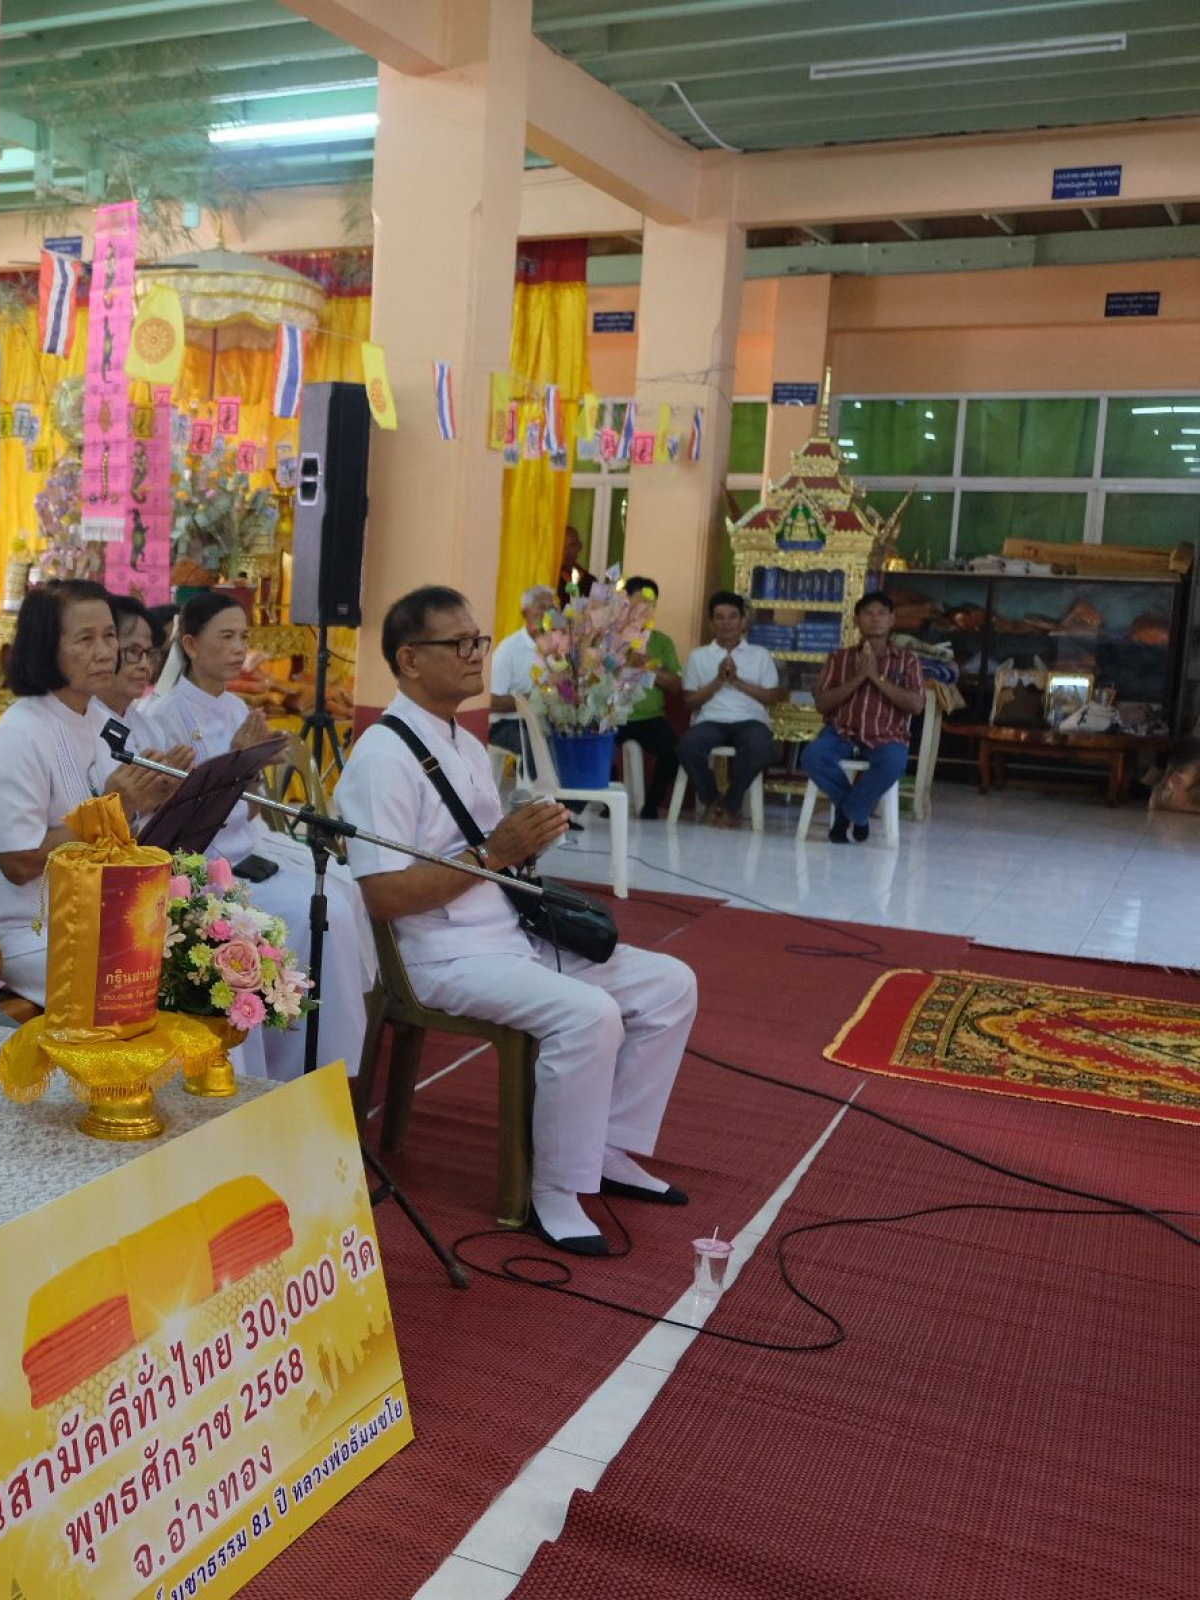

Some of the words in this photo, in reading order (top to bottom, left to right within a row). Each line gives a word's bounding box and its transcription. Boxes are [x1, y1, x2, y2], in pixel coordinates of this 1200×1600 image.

[241, 1259, 335, 1350] 30,000
[342, 1230, 376, 1279] วัด
[65, 1403, 232, 1563] พุทธศักราช
[239, 1348, 305, 1423] 2568
[133, 1444, 273, 1578] จ.อ่างทอง
[171, 1528, 247, 1600] บชาธรรม
[252, 1506, 272, 1537] 81
[273, 1486, 288, 1515] ปี
[291, 1397, 404, 1503] หลวงพ่อธัมมชโย
